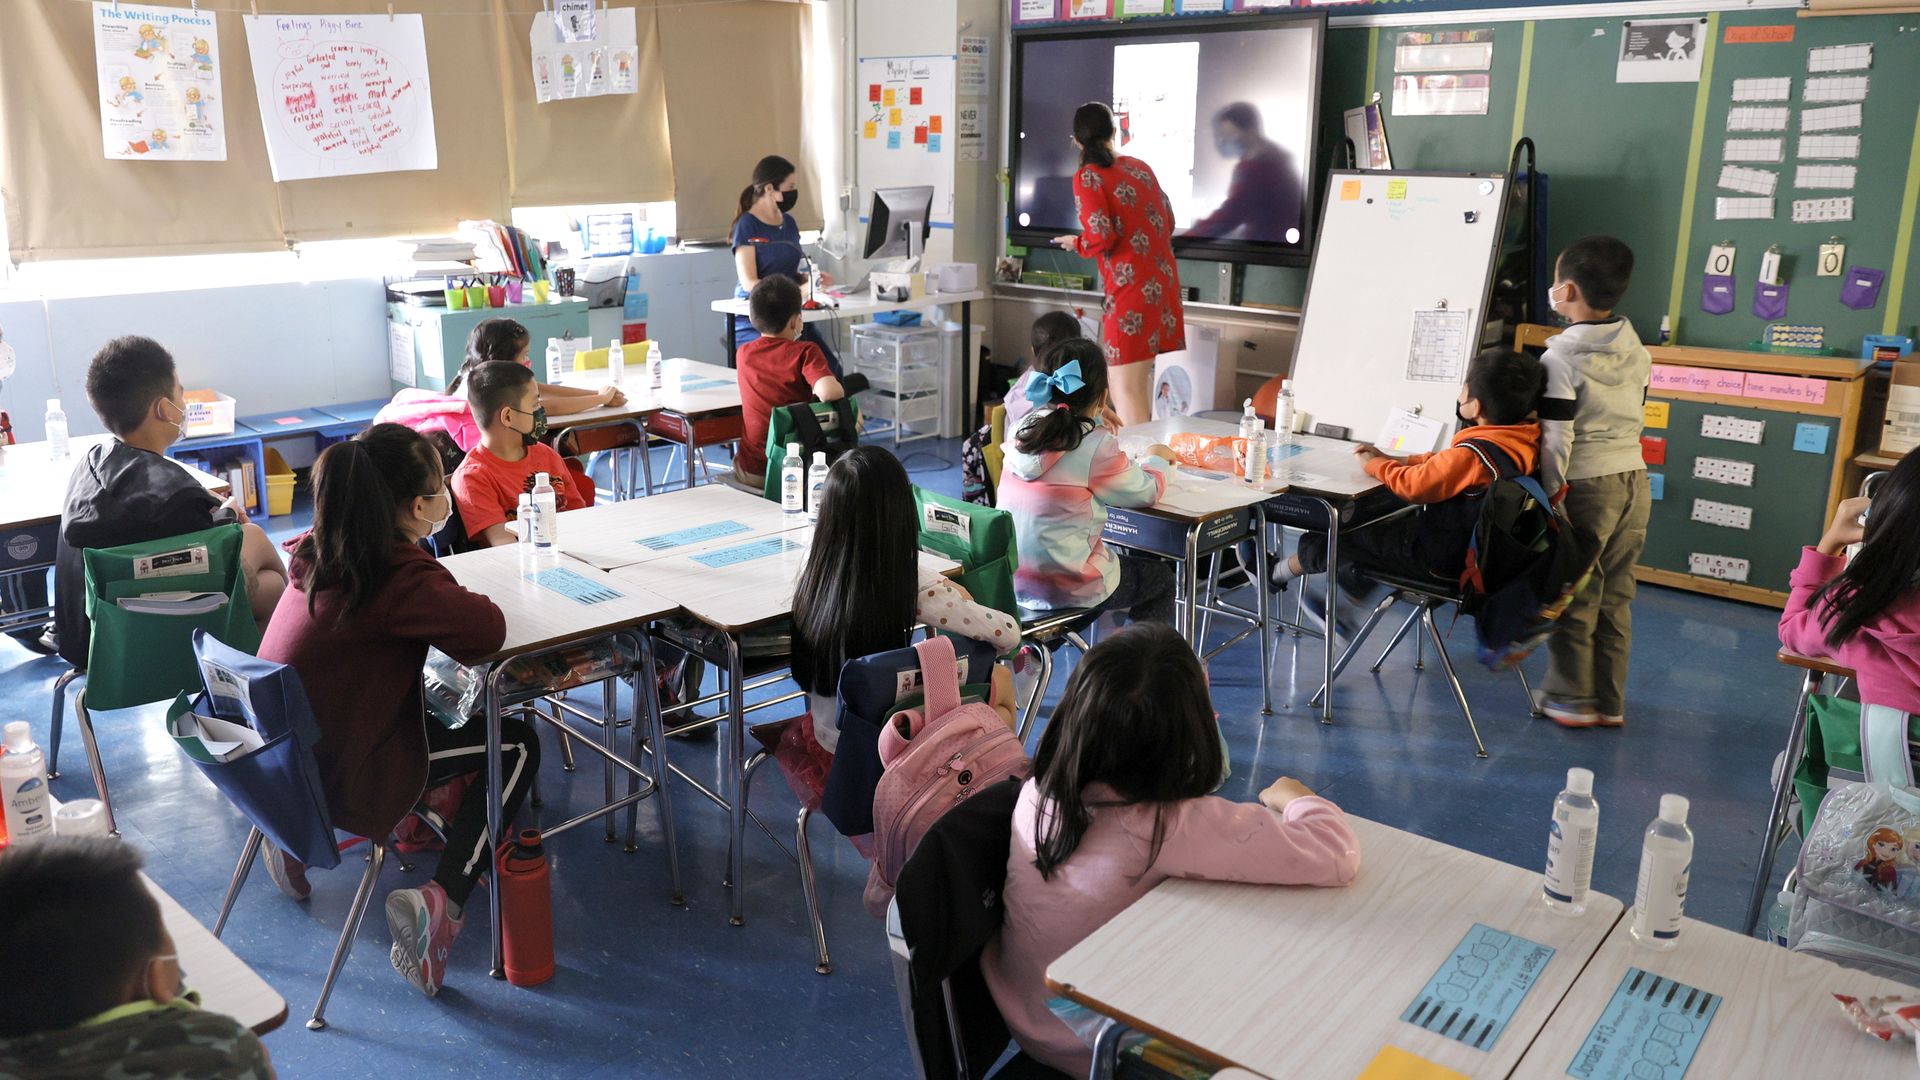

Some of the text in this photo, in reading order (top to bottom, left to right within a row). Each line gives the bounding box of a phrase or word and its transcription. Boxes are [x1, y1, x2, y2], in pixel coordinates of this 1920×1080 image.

[100, 8, 212, 25] The Writing Process
[276, 19, 312, 33] Feelings
[320, 18, 342, 34] Piggy
[293, 109, 324, 123] relaxed
[960, 111, 977, 120] NEVER
[1652, 370, 1666, 383] We
[1717, 376, 1743, 390] choice
[1747, 379, 1765, 392] time
[1770, 382, 1802, 396] minutes
[1263, 502, 1310, 515] HAMMERMILL
[1206, 521, 1238, 537] HAMMERMILL
[1693, 555, 1745, 570] clean
[1709, 567, 1726, 577] up
[1511, 946, 1551, 991] Megan #17
[1574, 1024, 1617, 1078] Jordan #13
